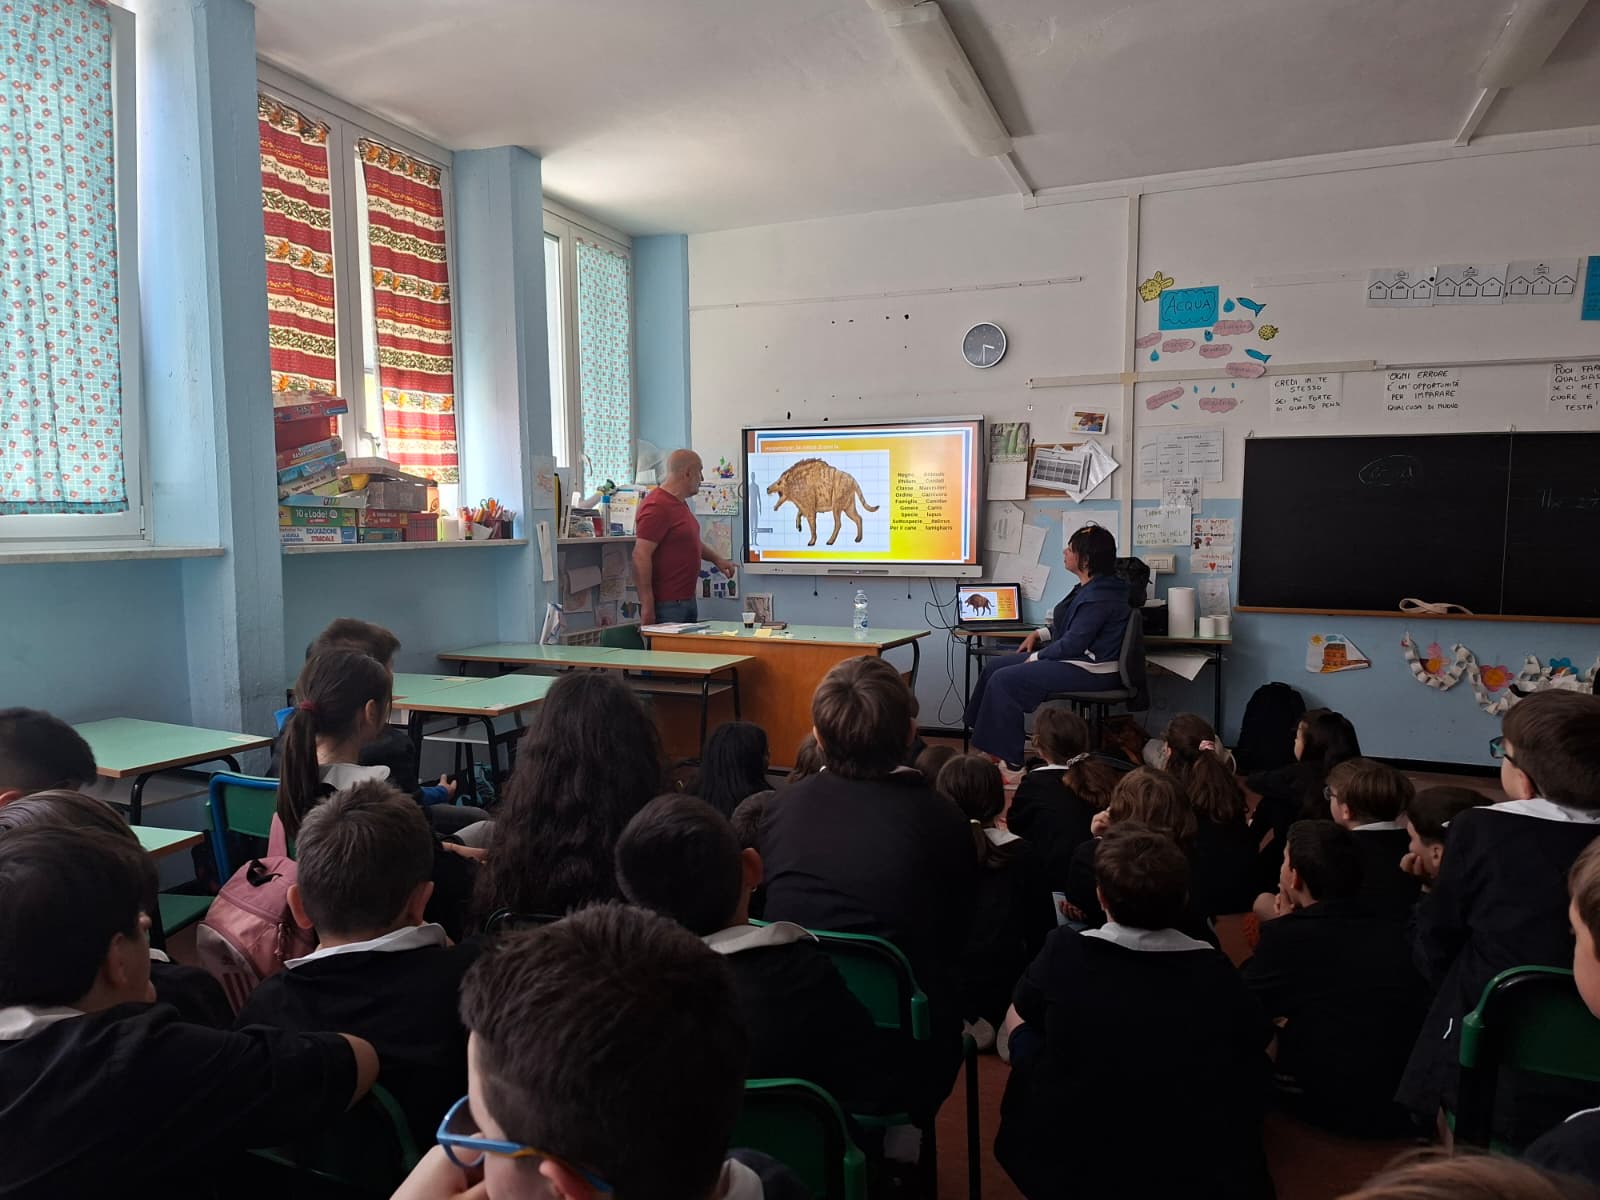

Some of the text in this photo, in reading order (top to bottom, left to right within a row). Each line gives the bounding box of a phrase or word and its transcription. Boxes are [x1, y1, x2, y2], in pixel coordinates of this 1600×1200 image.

[1165, 295, 1211, 315] ACQUA
[1417, 370, 1449, 379] ERRORE
[1275, 379, 1298, 387] CREDI
[1290, 385, 1322, 393] STESSO
[1414, 390, 1456, 399] IMPARARE
[1550, 393, 1577, 401] CUORE
[1289, 403, 1316, 411] QUANTO
[296, 509, 303, 518] 10
